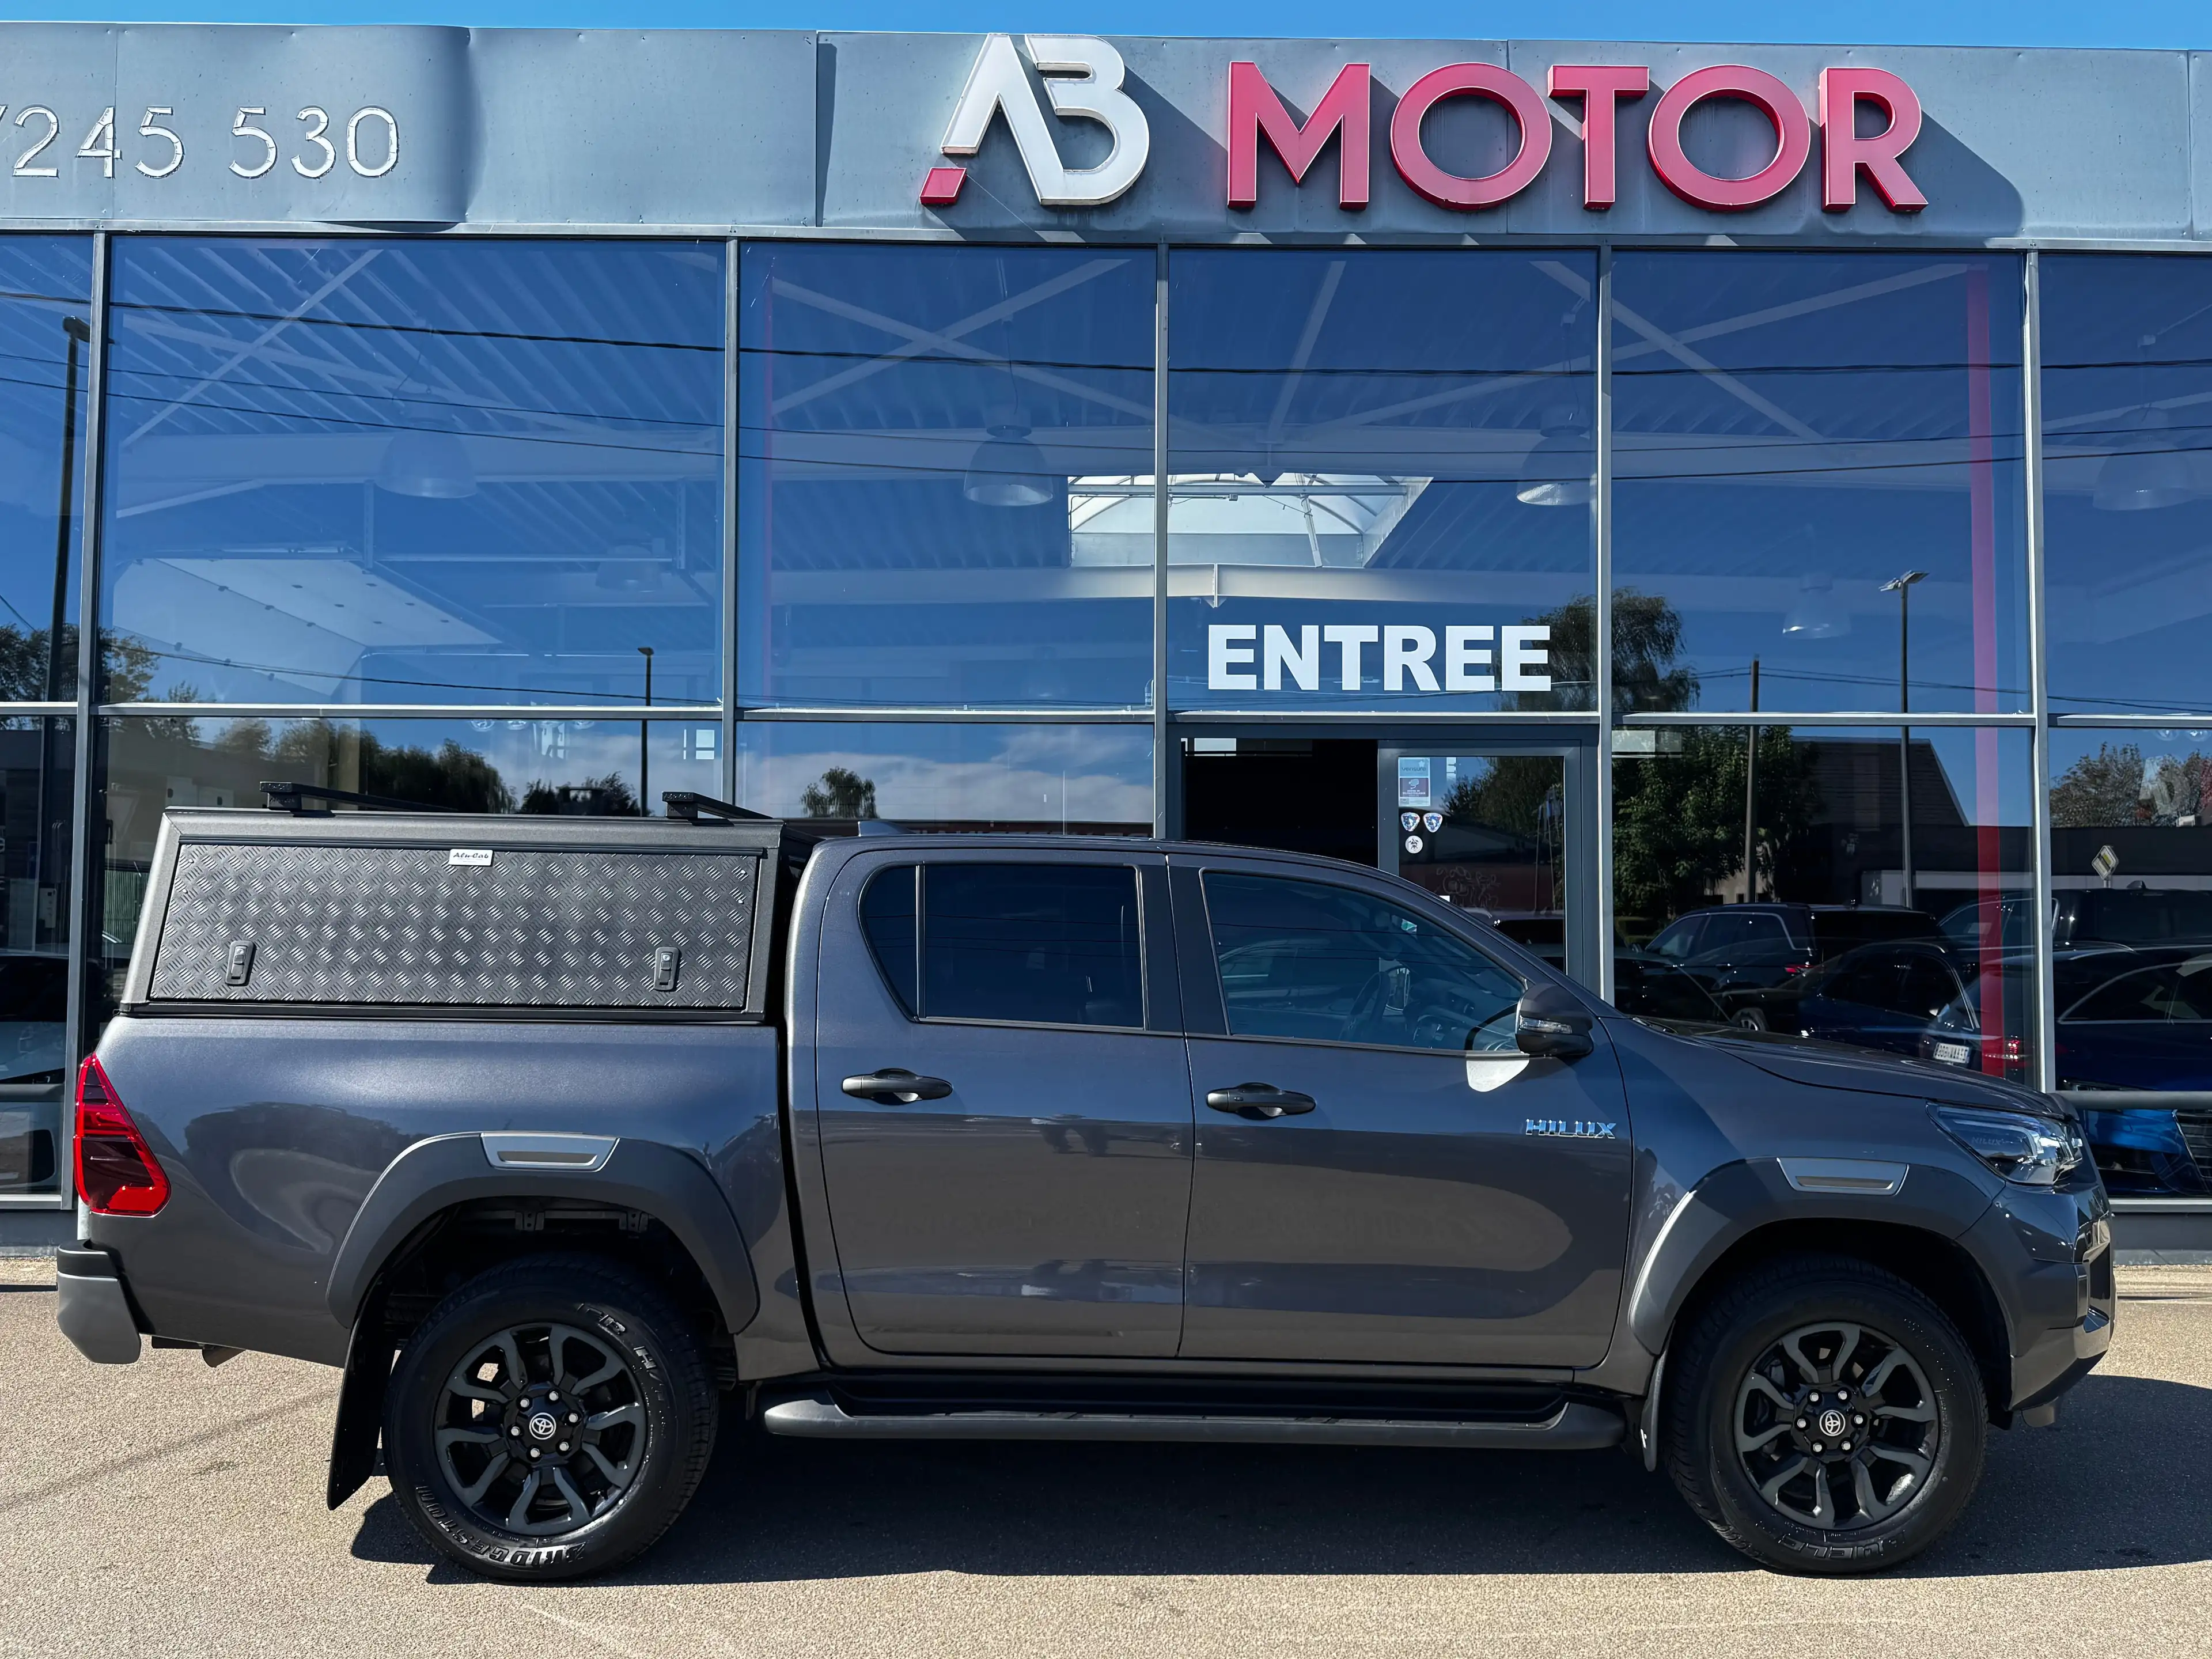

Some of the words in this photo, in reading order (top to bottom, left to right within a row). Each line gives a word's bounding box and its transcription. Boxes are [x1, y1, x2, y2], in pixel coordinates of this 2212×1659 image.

[0, 105, 185, 179] 245
[229, 105, 399, 179] 530
[1226, 62, 1929, 213] MOTOR
[1208, 625, 1551, 691] ENTREE
[1526, 1119, 1616, 1139] HILUX
[415, 1484, 587, 1567] BRIDGESTON
